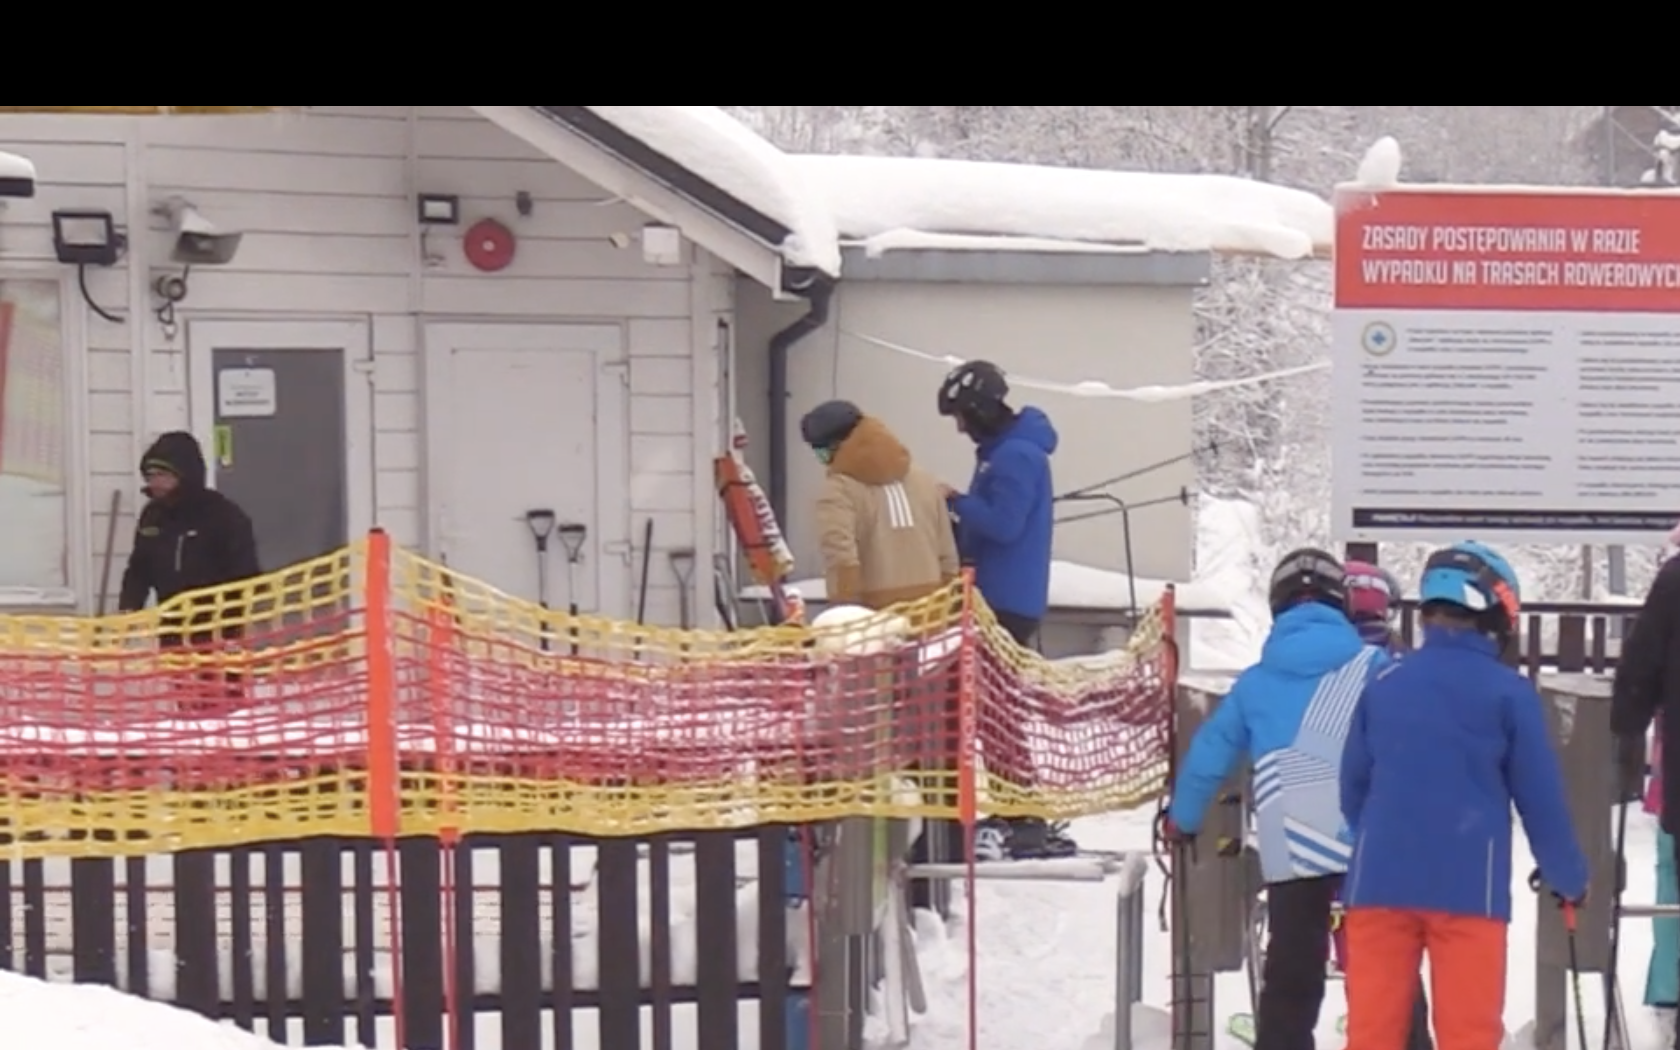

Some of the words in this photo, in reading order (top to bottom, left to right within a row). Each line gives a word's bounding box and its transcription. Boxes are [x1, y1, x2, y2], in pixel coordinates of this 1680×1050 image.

[1362, 226, 1429, 250] ZASADY
[1433, 227, 1565, 255] POSTĘPOWANIA
[1570, 229, 1589, 253] W
[1593, 229, 1641, 254] RAZIE
[1362, 259, 1448, 285] WYPADKU
[1453, 261, 1477, 285] NA
[1481, 262, 1559, 286] TRASACH
